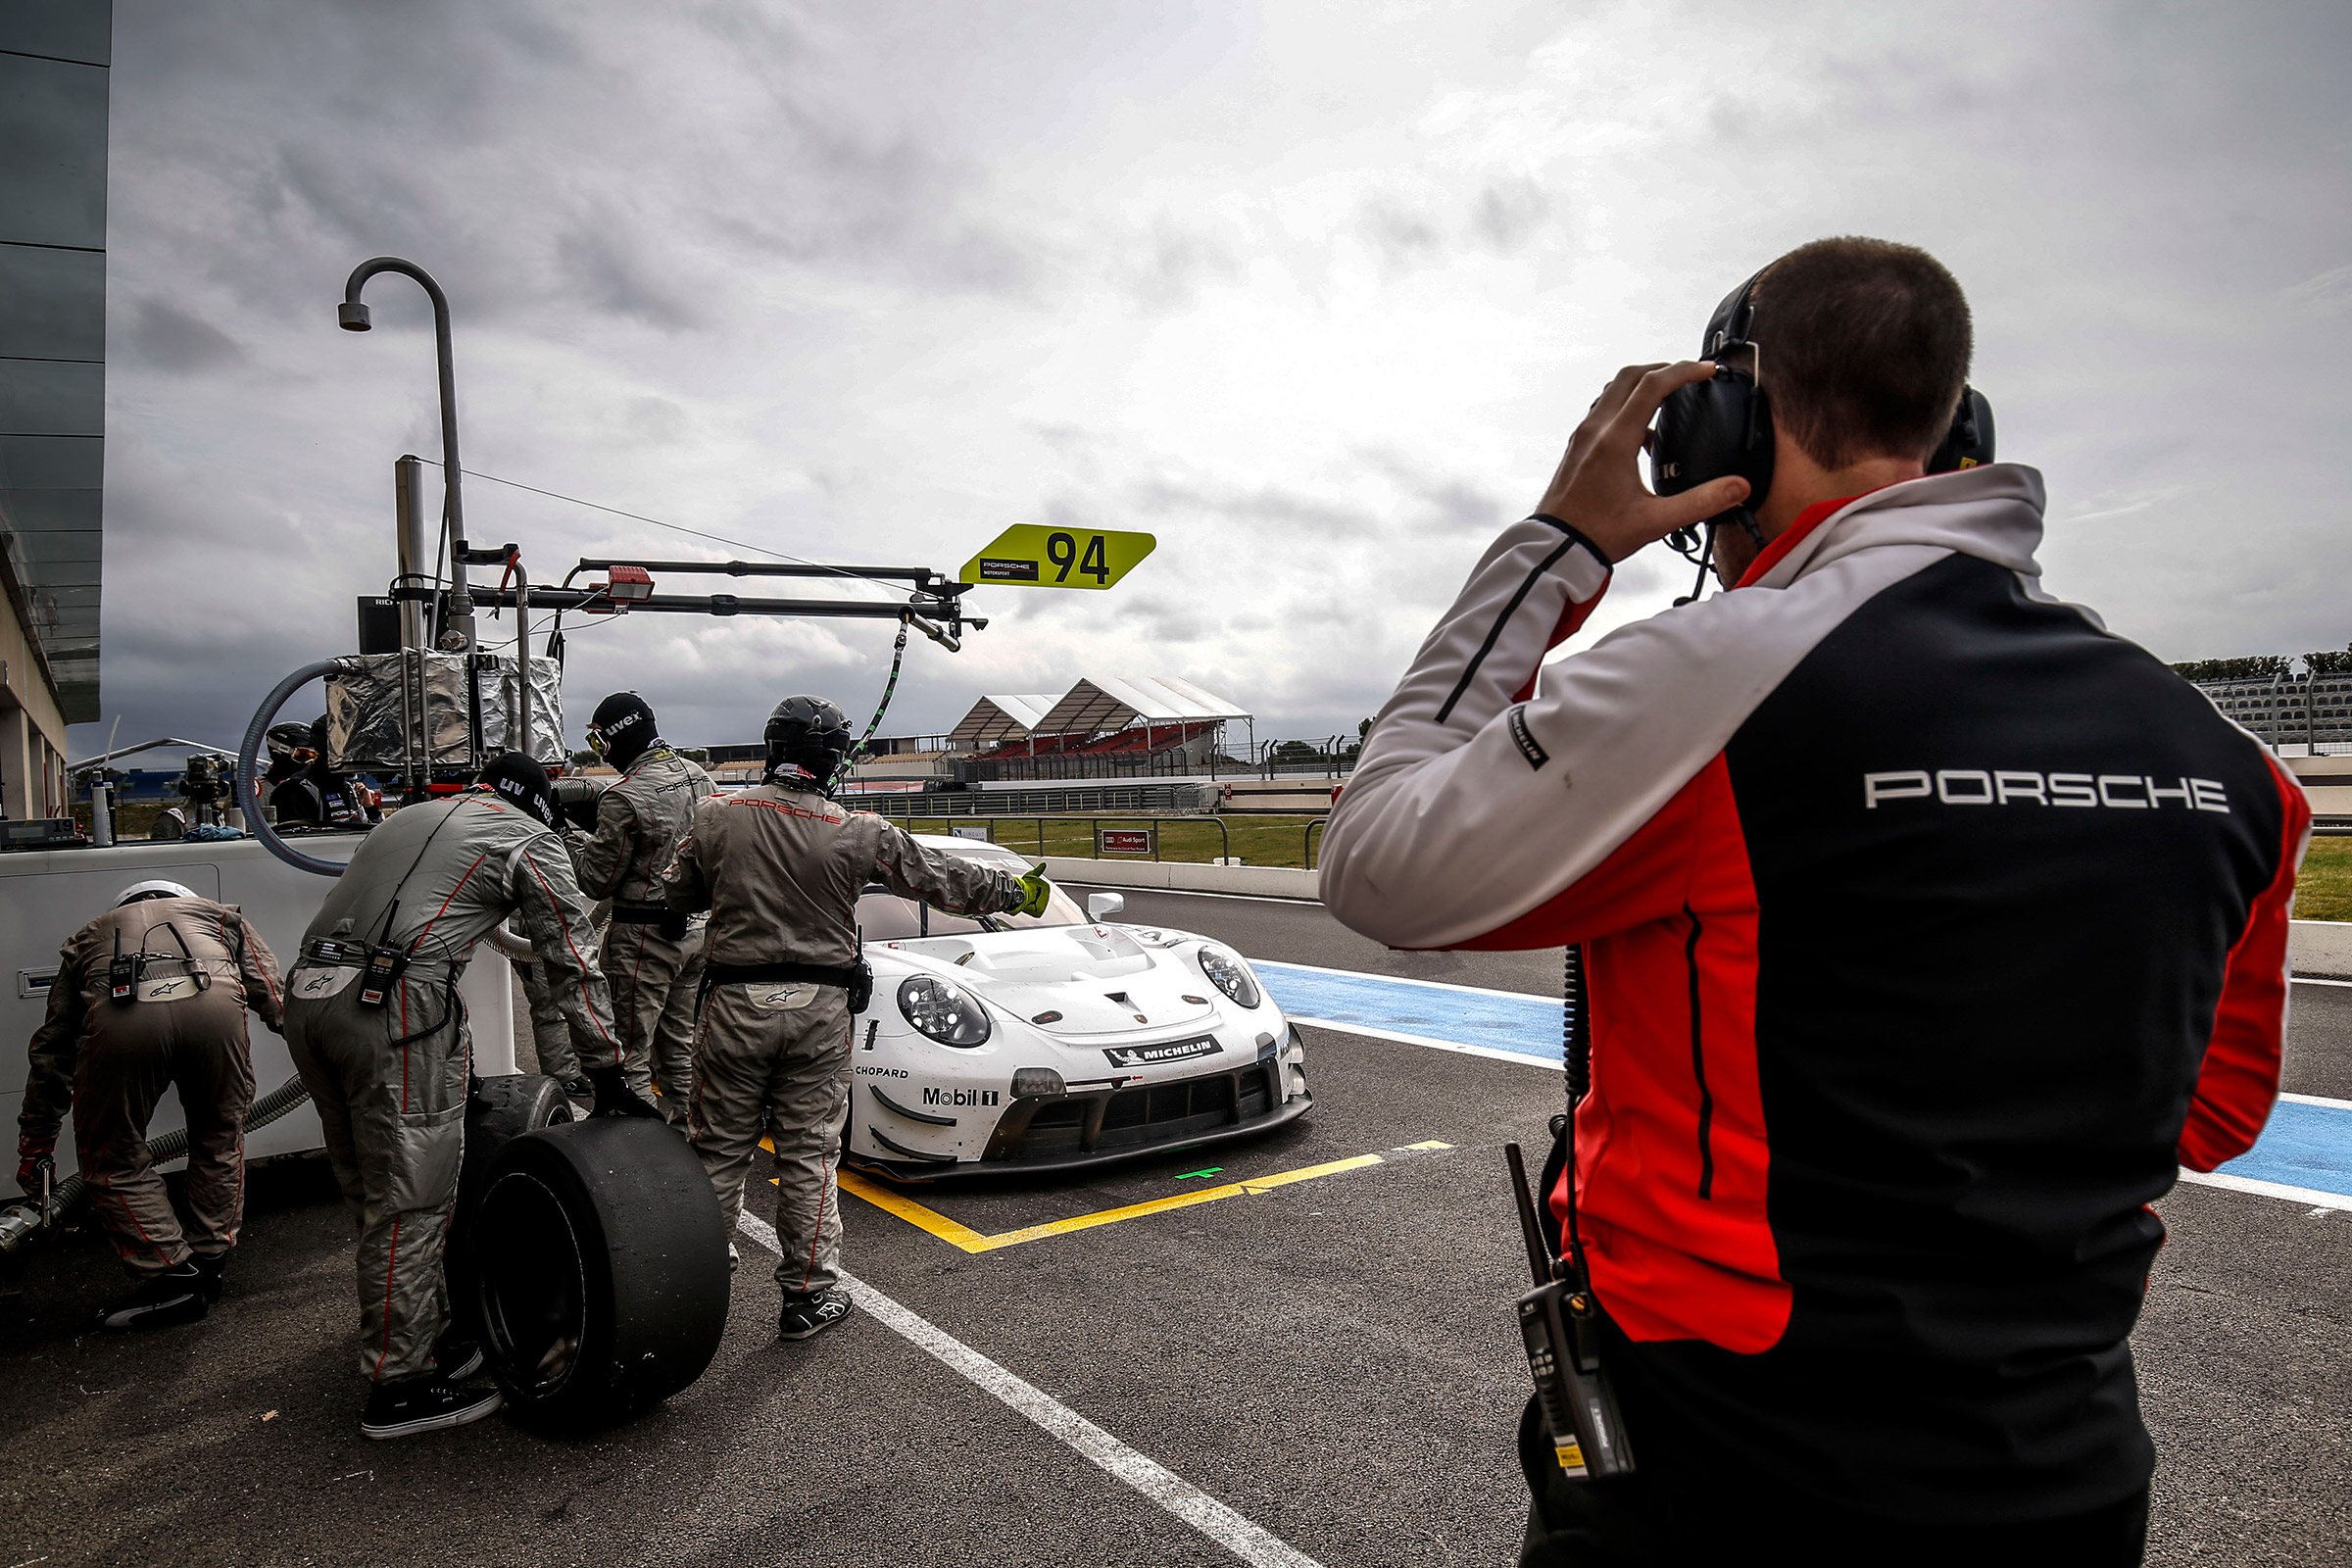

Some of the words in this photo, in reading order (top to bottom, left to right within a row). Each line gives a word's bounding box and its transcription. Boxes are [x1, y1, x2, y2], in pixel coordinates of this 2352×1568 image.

[1047, 532, 1109, 585] 94
[606, 711, 642, 737] uvex
[655, 775, 710, 795] PORSCHE
[1864, 770, 2230, 813] PORSCHE
[533, 793, 554, 826] uvex
[729, 799, 842, 825] PORSCHE
[53, 820, 74, 833] 19
[1144, 1041, 1211, 1059] MICHELIN
[856, 1066, 908, 1078] CHOPARD
[923, 1088, 977, 1105] Mobil
[984, 1091, 997, 1105] 1
